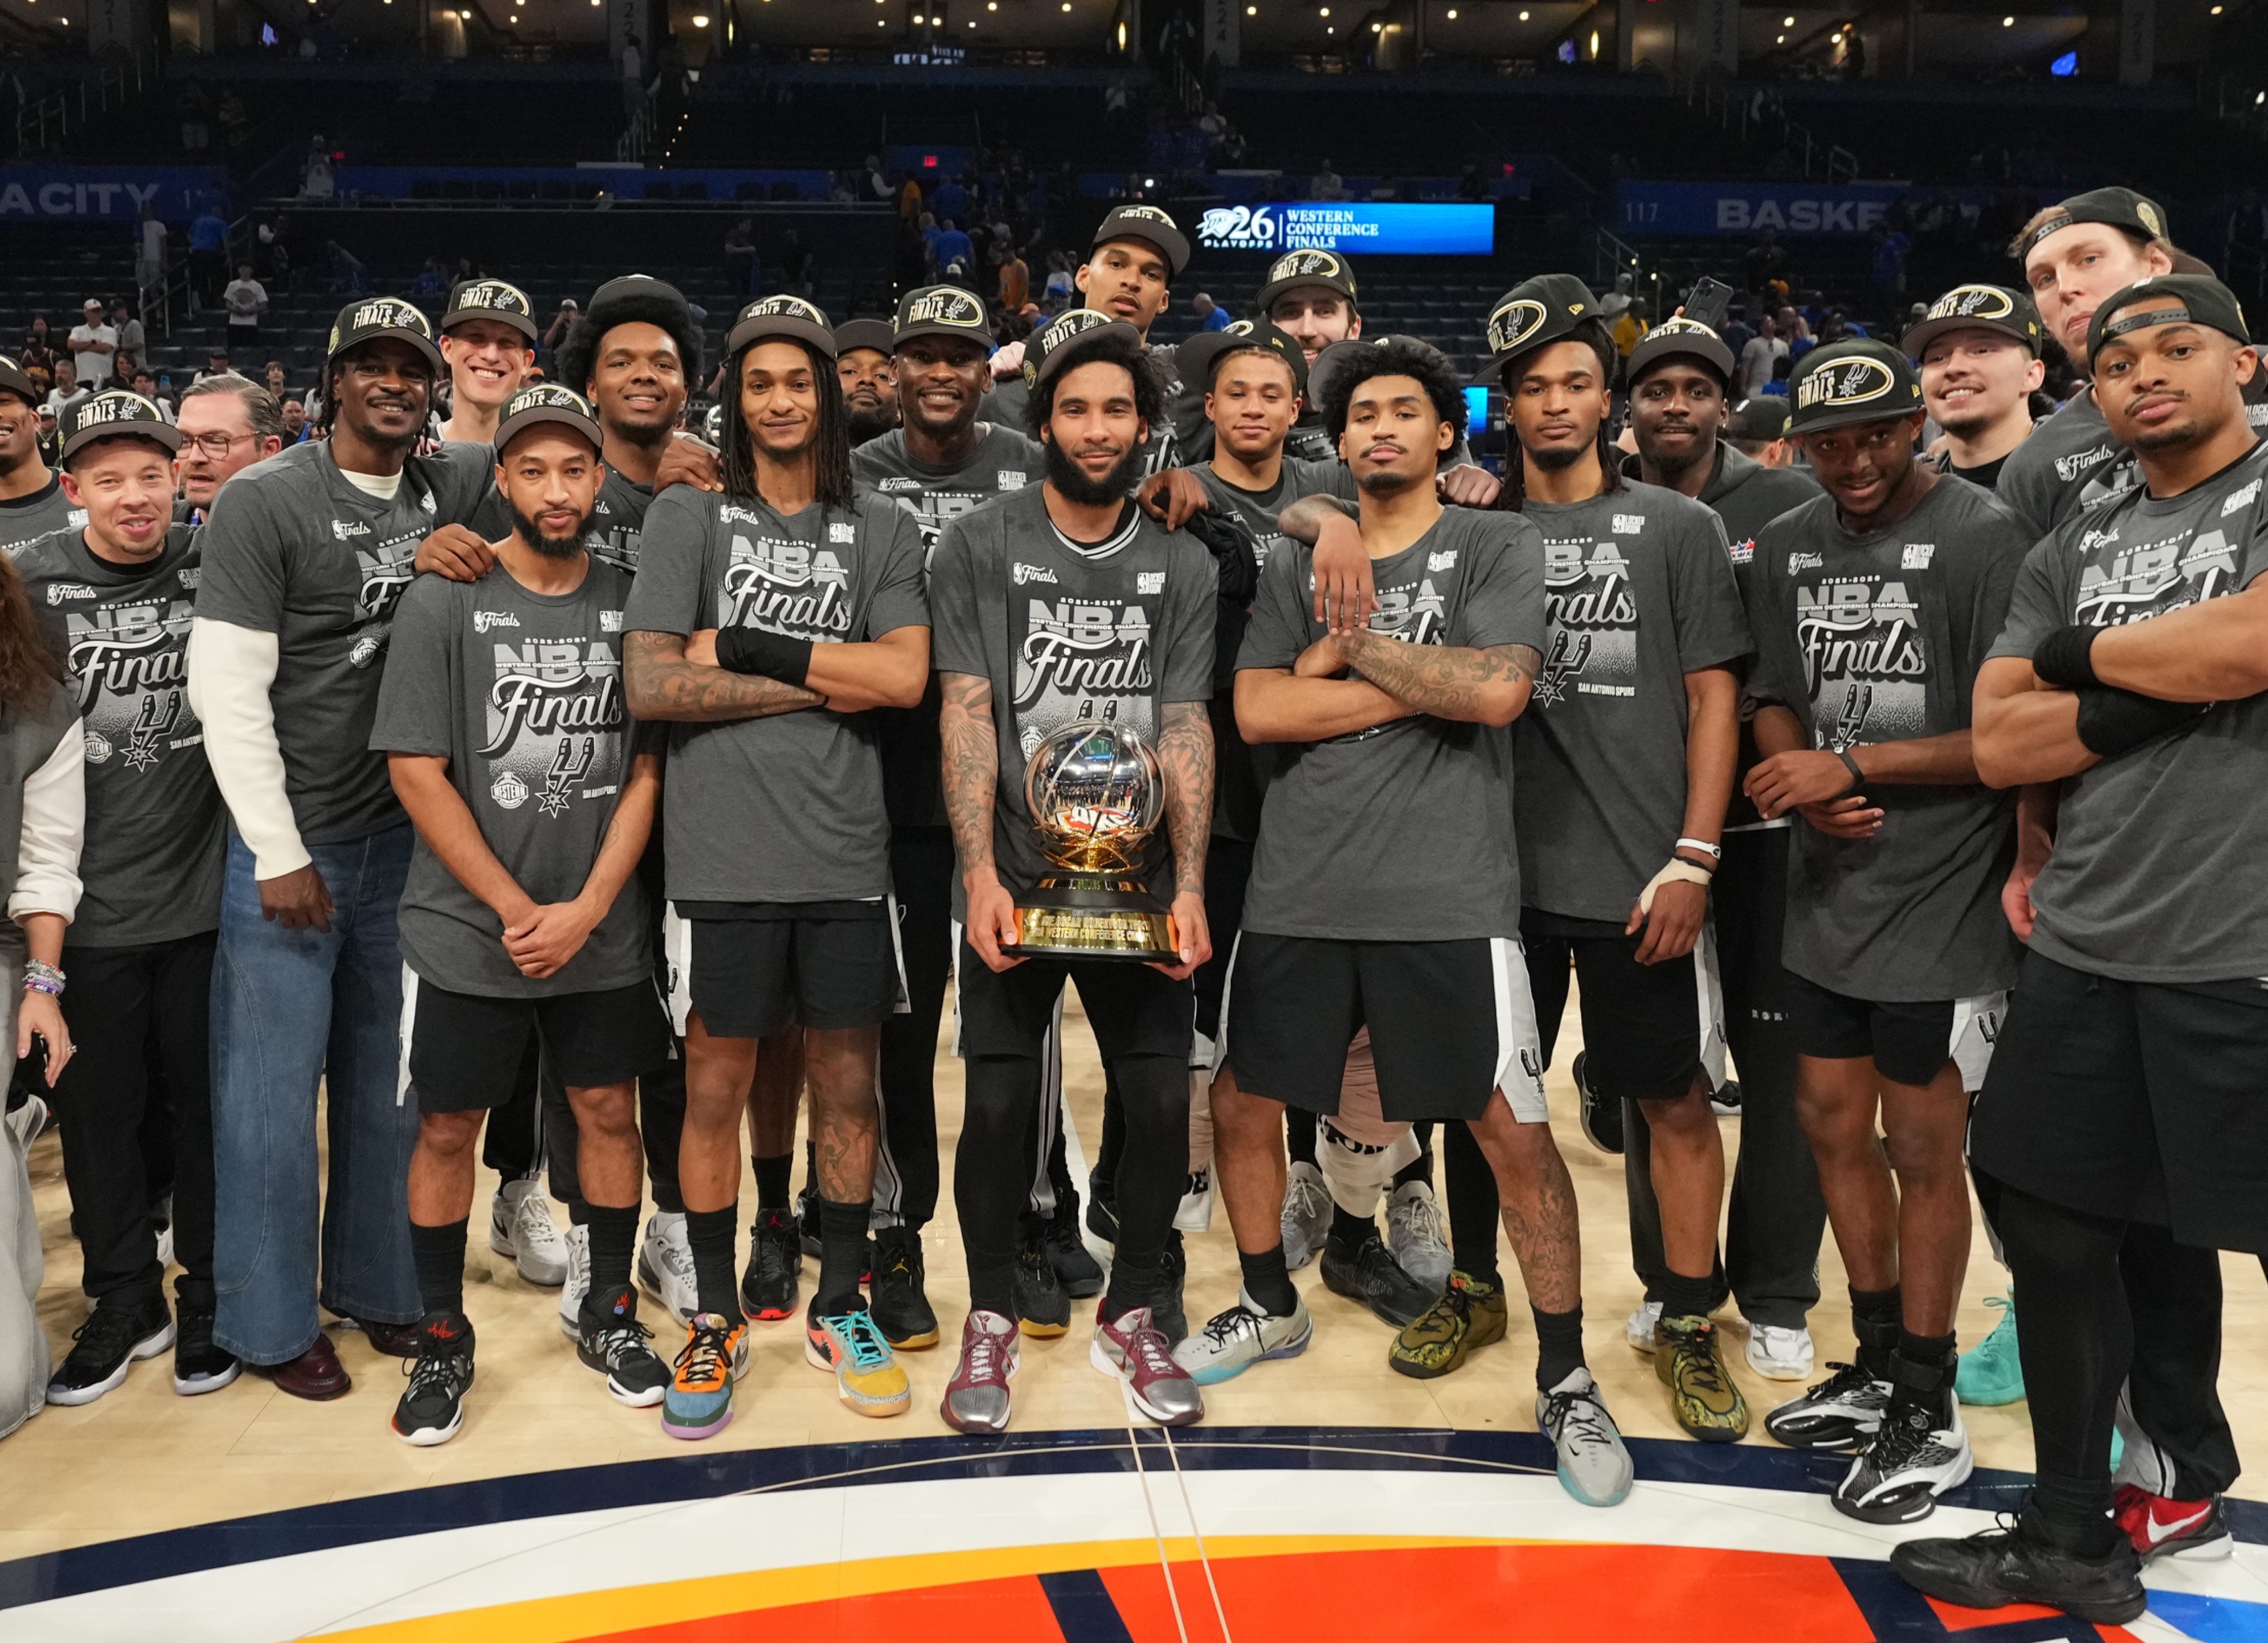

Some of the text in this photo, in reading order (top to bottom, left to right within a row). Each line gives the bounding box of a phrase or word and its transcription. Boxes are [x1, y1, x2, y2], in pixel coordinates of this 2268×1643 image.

[39, 183, 160, 214] CITY
[1286, 210, 1354, 223] WESTERN
[1625, 202, 1659, 223] 117
[1286, 223, 1379, 236] CONFERENCE
[1203, 239, 1274, 249] PLAYOFFS
[1286, 235, 1337, 248] FINALS
[458, 291, 493, 309] FINALS
[353, 308, 393, 330] FINALS
[908, 301, 944, 324] FINALS
[1798, 376, 1836, 410] FINALS
[76, 405, 116, 431] FINALS
[2067, 444, 2115, 482] Finals
[724, 507, 759, 525] Finals
[1625, 515, 1646, 525] LOCKER
[1625, 524, 1641, 534] ROOM
[1544, 536, 1593, 545] 25-2026
[730, 534, 848, 591] NBA
[731, 551, 764, 562] WESTERN
[1545, 542, 1630, 582] BA
[1792, 552, 1823, 576] Finals
[2078, 529, 2237, 604] NBA
[1018, 564, 1058, 585] Finals
[2080, 578, 2118, 592] WESTERN
[2178, 544, 2238, 566] CHAMPIONS
[50, 585, 96, 606] Finals
[725, 564, 852, 631] Finals
[1545, 573, 1637, 624] nals
[1797, 582, 1918, 629] NBA
[107, 622, 158, 632] CONFERENCE
[161, 617, 194, 625] CHAMPIO
[478, 611, 520, 634] Finals
[1028, 598, 1150, 648] NBA
[1029, 618, 1064, 627] WESTERN
[1064, 622, 1112, 631] CONFERENCE
[494, 642, 620, 683] NBA
[1797, 617, 1926, 695] Finals
[68, 631, 192, 704] Fina
[1013, 631, 1152, 705] Finals
[1578, 682, 1635, 696] SAN ANTONIO SPURS
[475, 673, 622, 753] Finals
[169, 740, 182, 750] SAN
[492, 784, 525, 800] WESTERN
[1046, 927, 1078, 939] WESTERN
[1080, 928, 1126, 941] CONFERENCE
